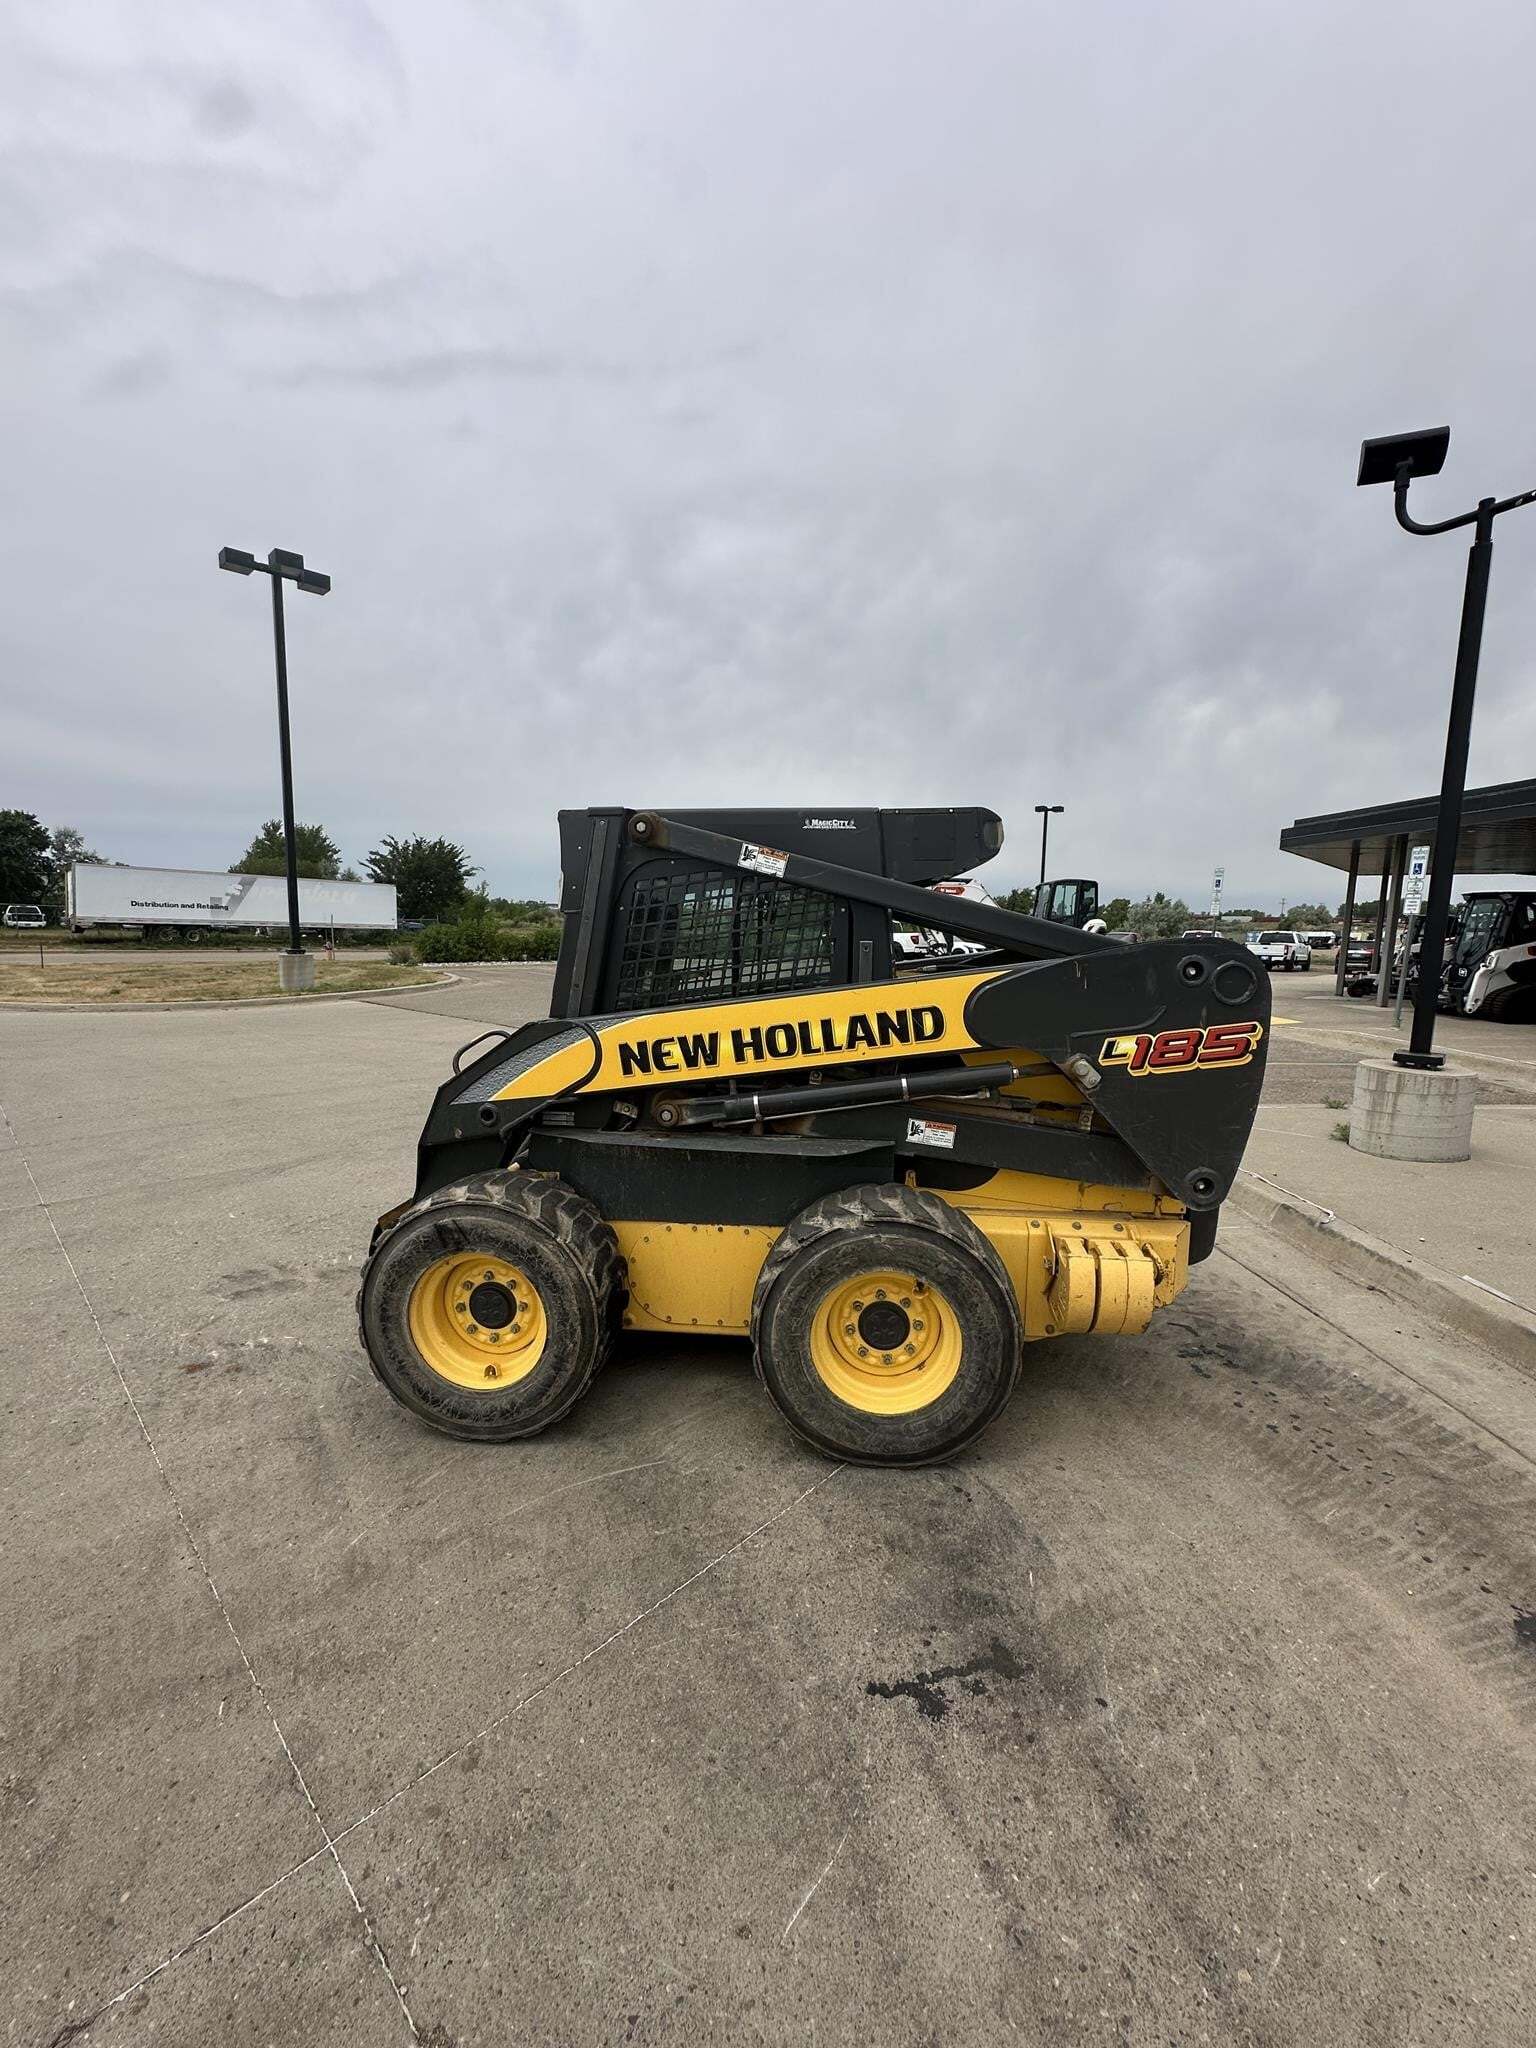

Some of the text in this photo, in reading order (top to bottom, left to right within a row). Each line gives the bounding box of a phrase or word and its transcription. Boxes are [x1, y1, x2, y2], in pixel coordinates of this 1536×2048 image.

[130, 900, 179, 909] Distribution
[196, 902, 229, 911] Retailing
[617, 1005, 945, 1077] NEW HOLLAND
[1098, 1020, 1264, 1077] L185
